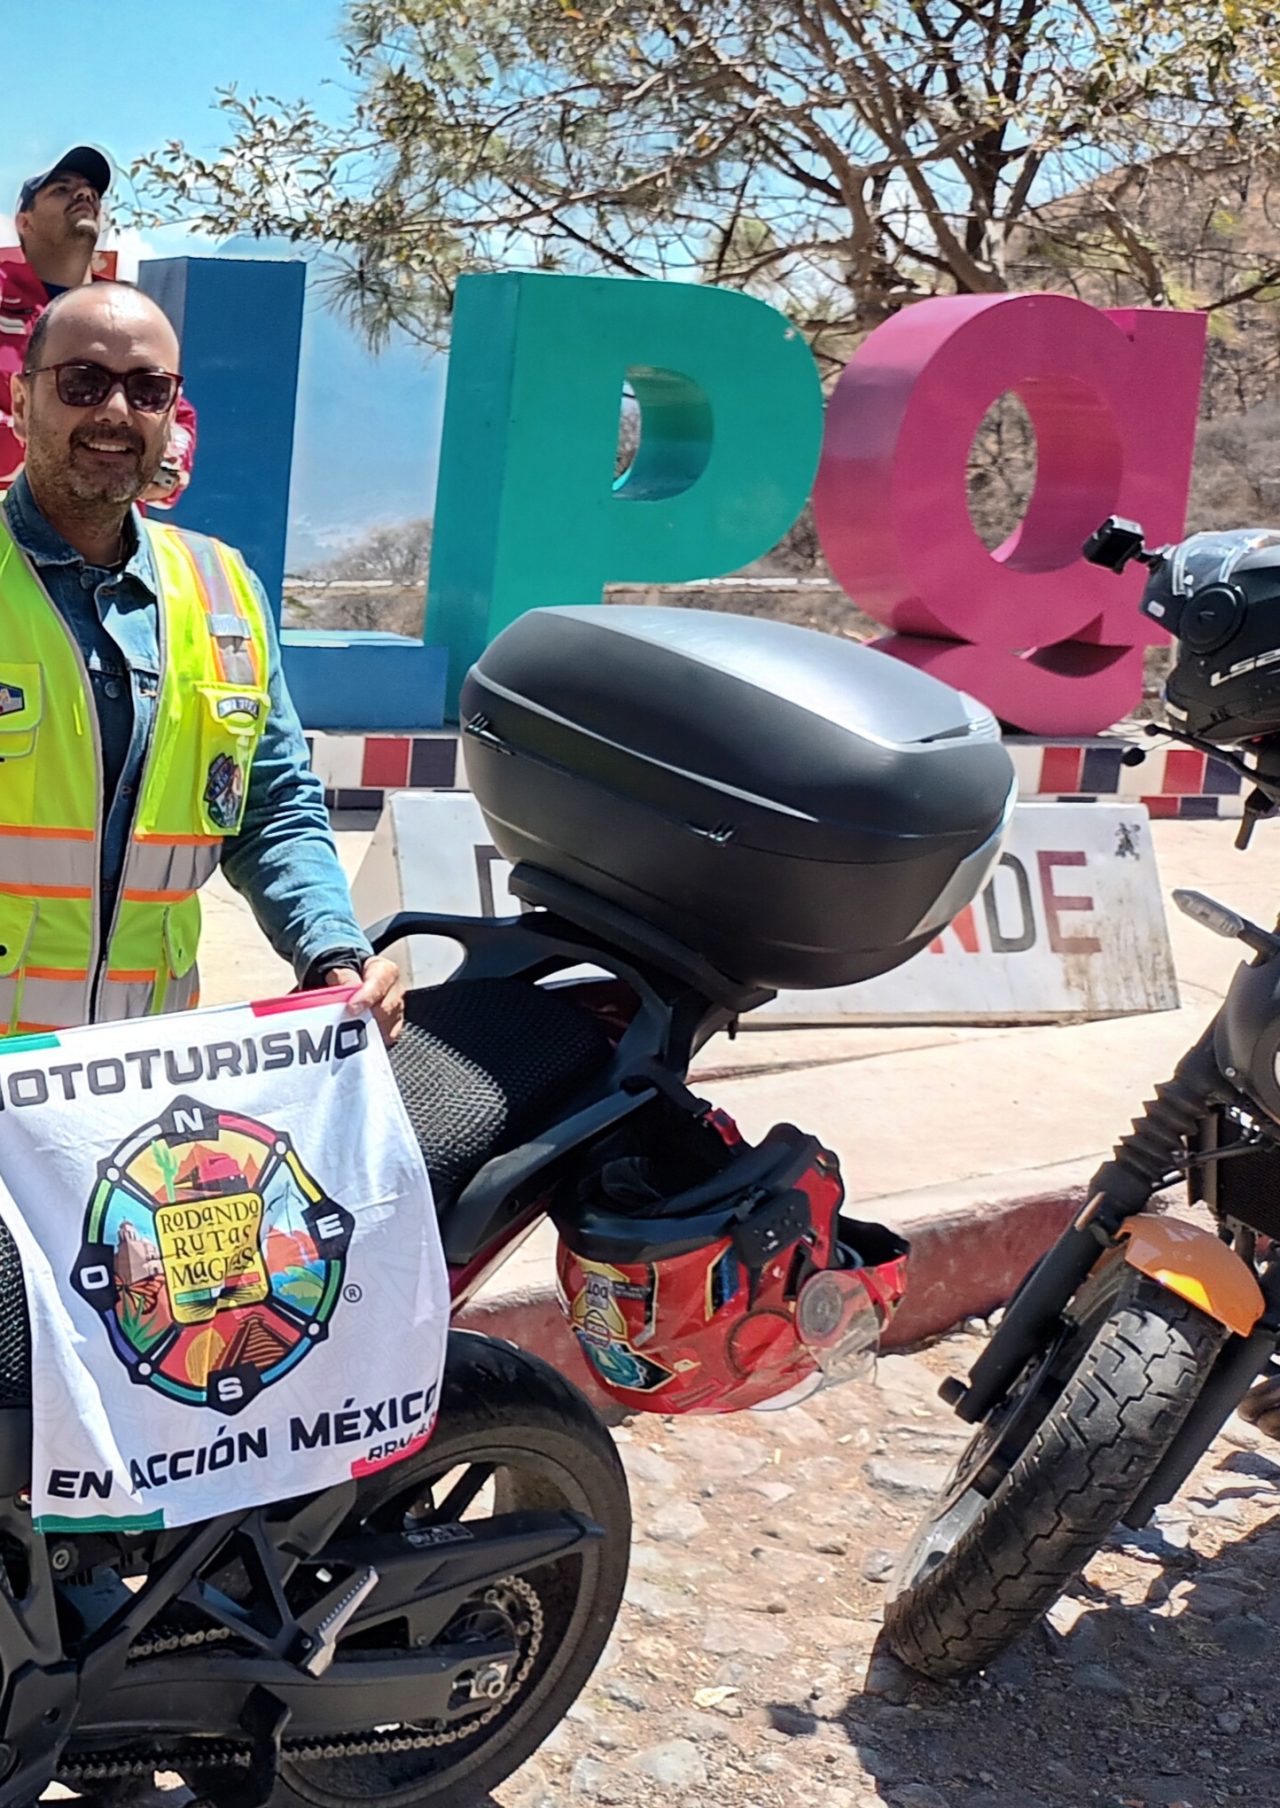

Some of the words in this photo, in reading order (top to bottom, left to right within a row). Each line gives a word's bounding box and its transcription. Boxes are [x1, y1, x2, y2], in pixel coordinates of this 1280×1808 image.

[172, 1107, 204, 1134] N
[217, 1376, 243, 1401] S
[46, 1468, 114, 1499] EN
[129, 1424, 269, 1496] ACCIÓN
